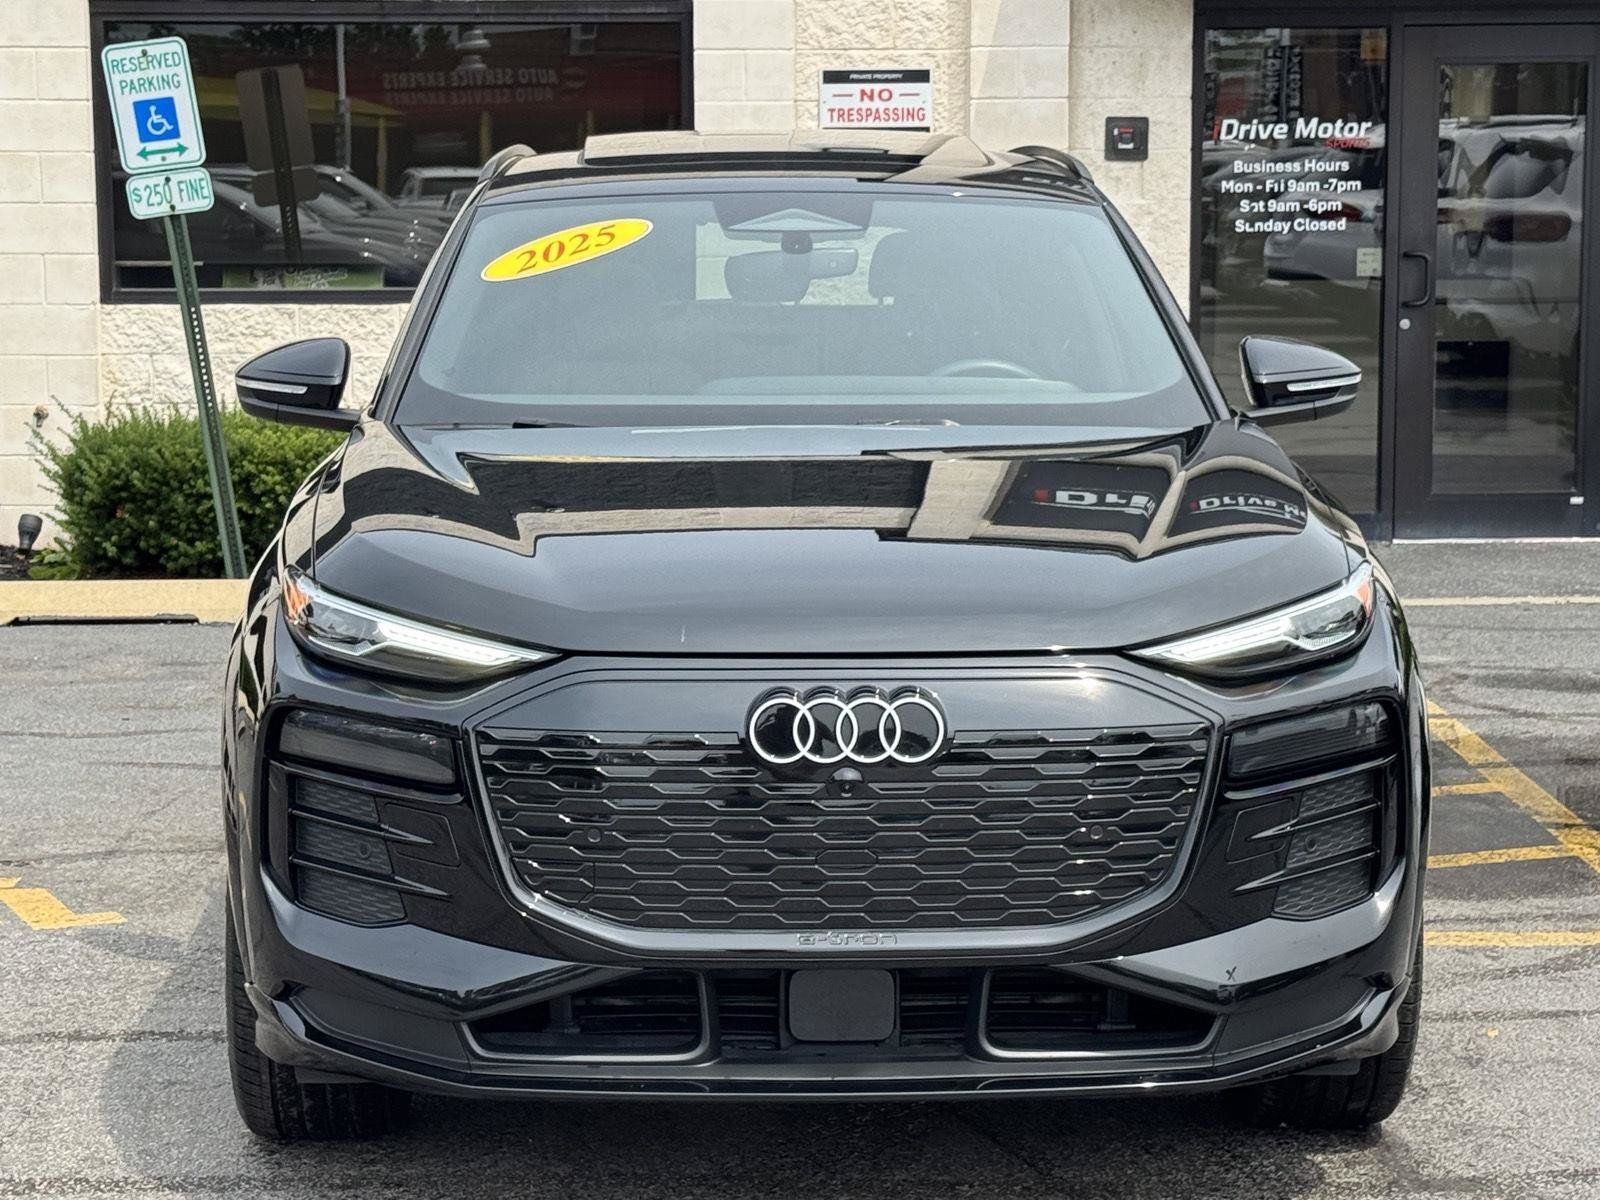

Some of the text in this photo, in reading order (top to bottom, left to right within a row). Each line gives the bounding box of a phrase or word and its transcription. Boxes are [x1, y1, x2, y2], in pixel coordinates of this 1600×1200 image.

[111, 51, 181, 74] RESERVED
[119, 73, 181, 95] PARKING
[860, 88, 893, 102] NO
[827, 107, 926, 123] TRESPASSING
[1294, 117, 1372, 139] Motor
[1233, 159, 1350, 174] Business Hours
[132, 177, 209, 207] $250 FINE
[1221, 180, 1253, 193] Mon
[1287, 179, 1320, 192] 9am
[1267, 199, 1300, 212] 9am
[1293, 217, 1347, 231] Closed
[516, 224, 617, 274] 2025
[797, 931, 898, 946] e-tron
